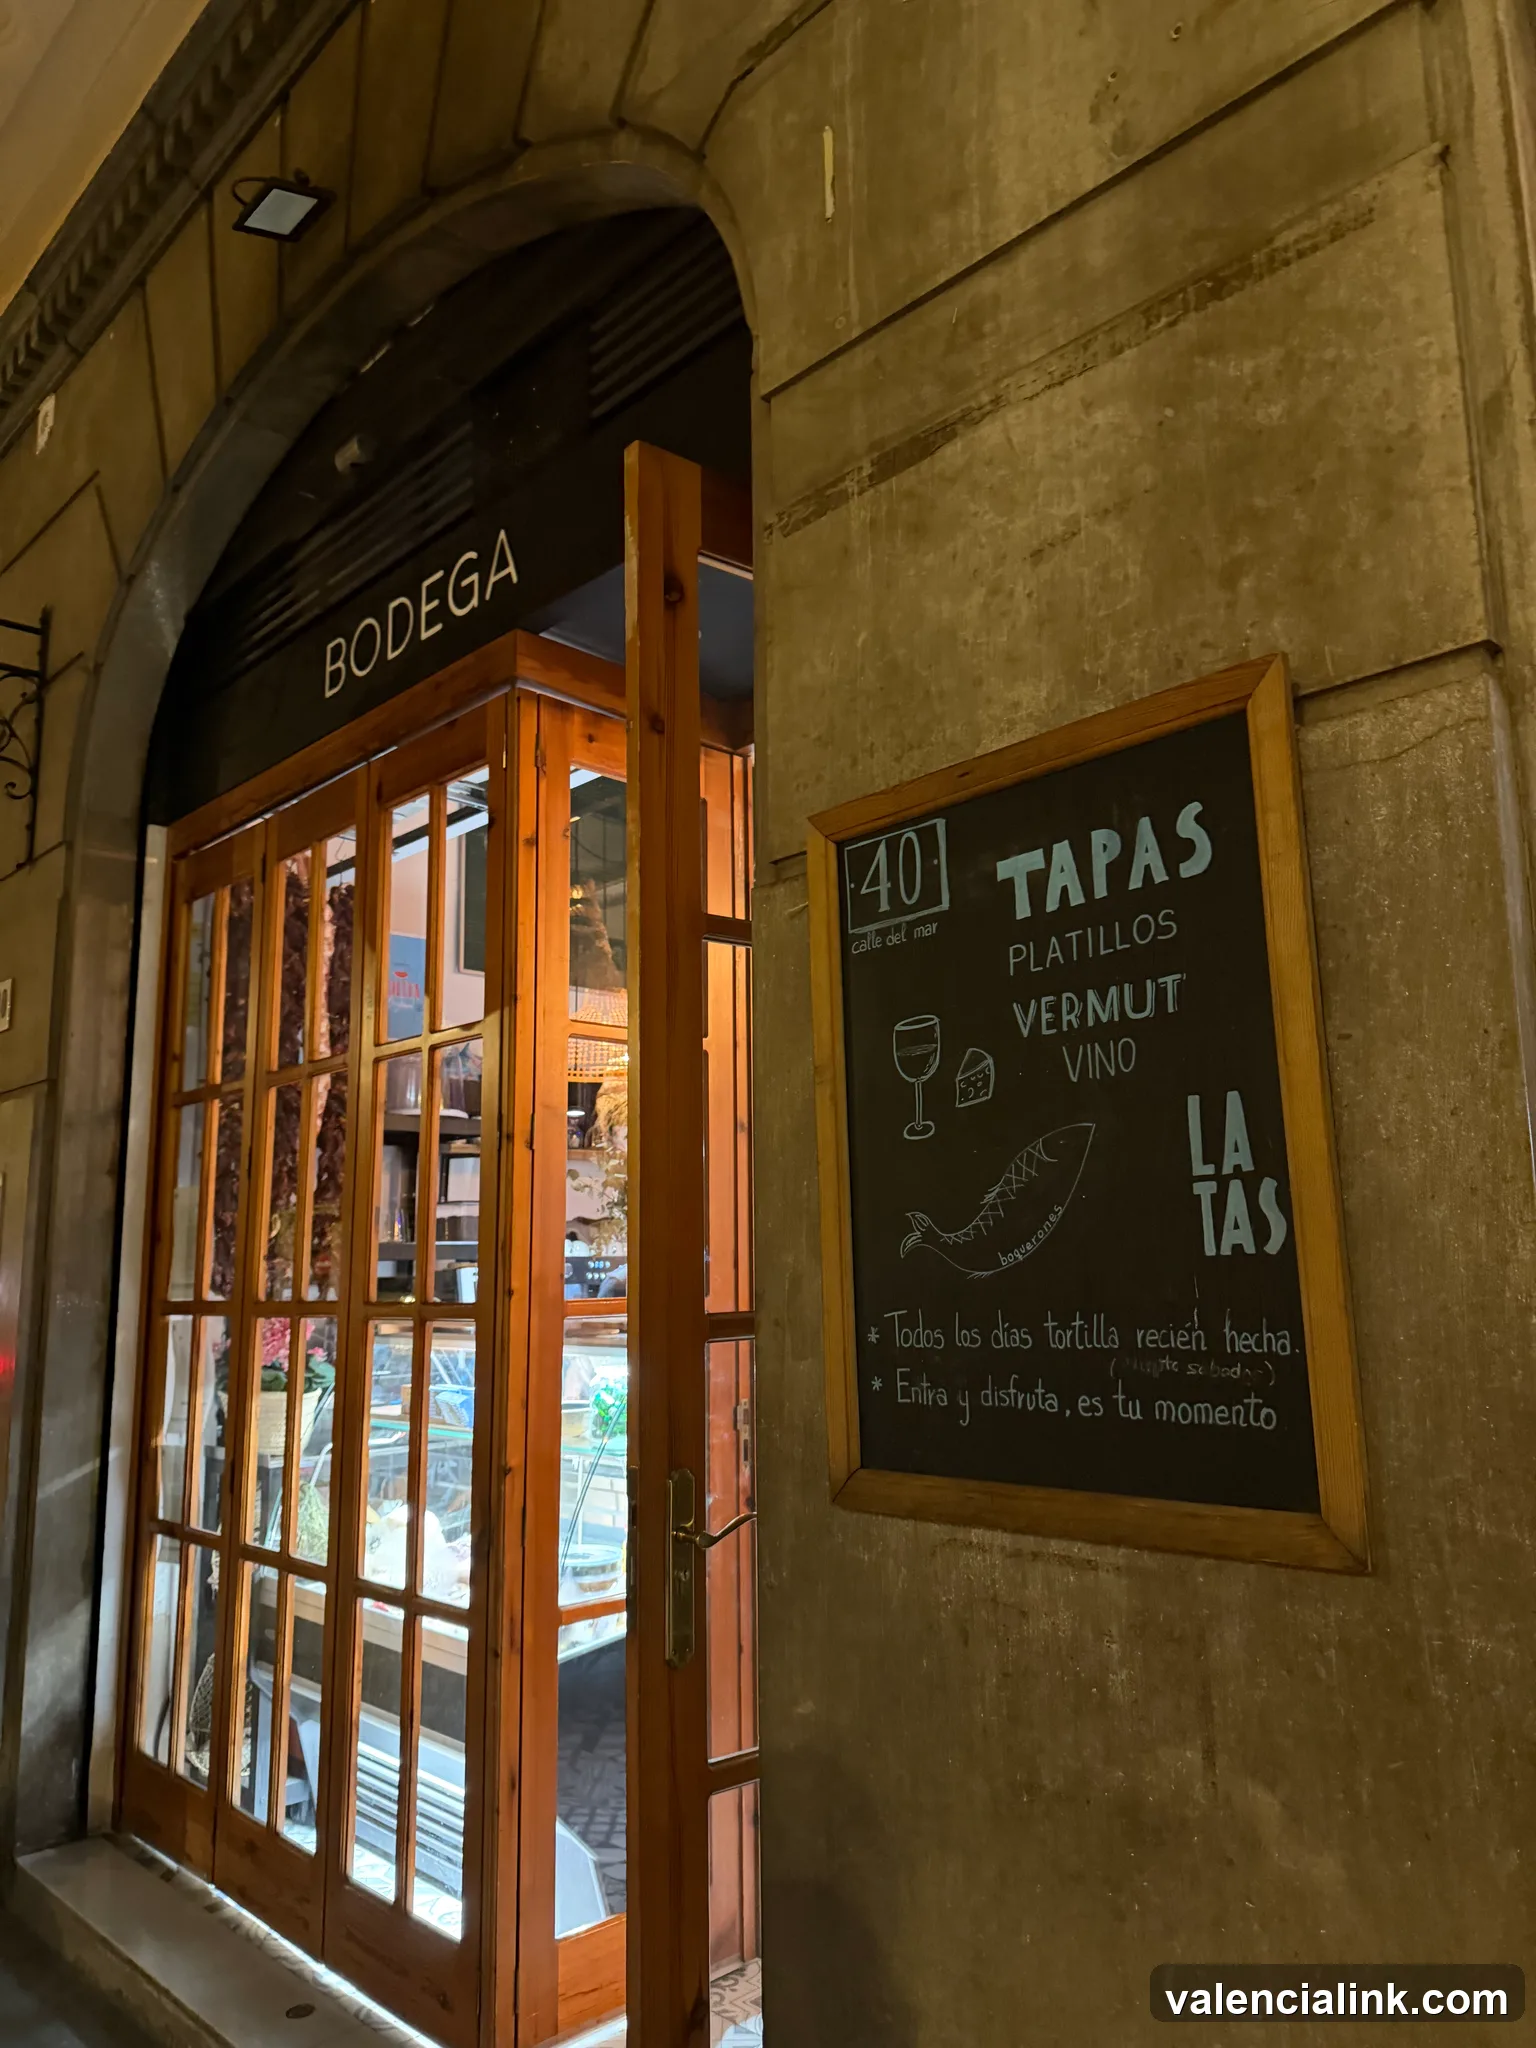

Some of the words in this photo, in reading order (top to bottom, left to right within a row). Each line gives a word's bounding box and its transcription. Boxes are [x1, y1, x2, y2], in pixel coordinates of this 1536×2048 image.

[325, 529, 518, 698] BODEGA
[860, 831, 922, 913] 40
[996, 801, 1213, 920] TAPAS
[851, 931, 882, 954] calle
[886, 923, 907, 946] del
[913, 922, 938, 939] mar
[1008, 909, 1178, 976] PLATILLOS
[1013, 973, 1184, 1038] VERMUT
[1062, 1037, 1137, 1082] VINO
[1187, 1091, 1254, 1176] LA
[997, 1204, 1064, 1266] boquerones
[1193, 1177, 1287, 1256] TAS
[883, 1308, 945, 1349] Todos
[955, 1312, 981, 1348] los
[991, 1309, 1033, 1349] días
[1043, 1311, 1120, 1349] tortilla
[1137, 1312, 1208, 1351] recién
[1223, 1308, 1300, 1355] hecha.
[896, 1368, 948, 1408] Entra
[959, 1390, 970, 1426] y
[981, 1374, 1071, 1418] disfruta,
[1078, 1394, 1104, 1417] es
[1112, 1378, 1143, 1421] tu
[1154, 1392, 1277, 1430] momento
